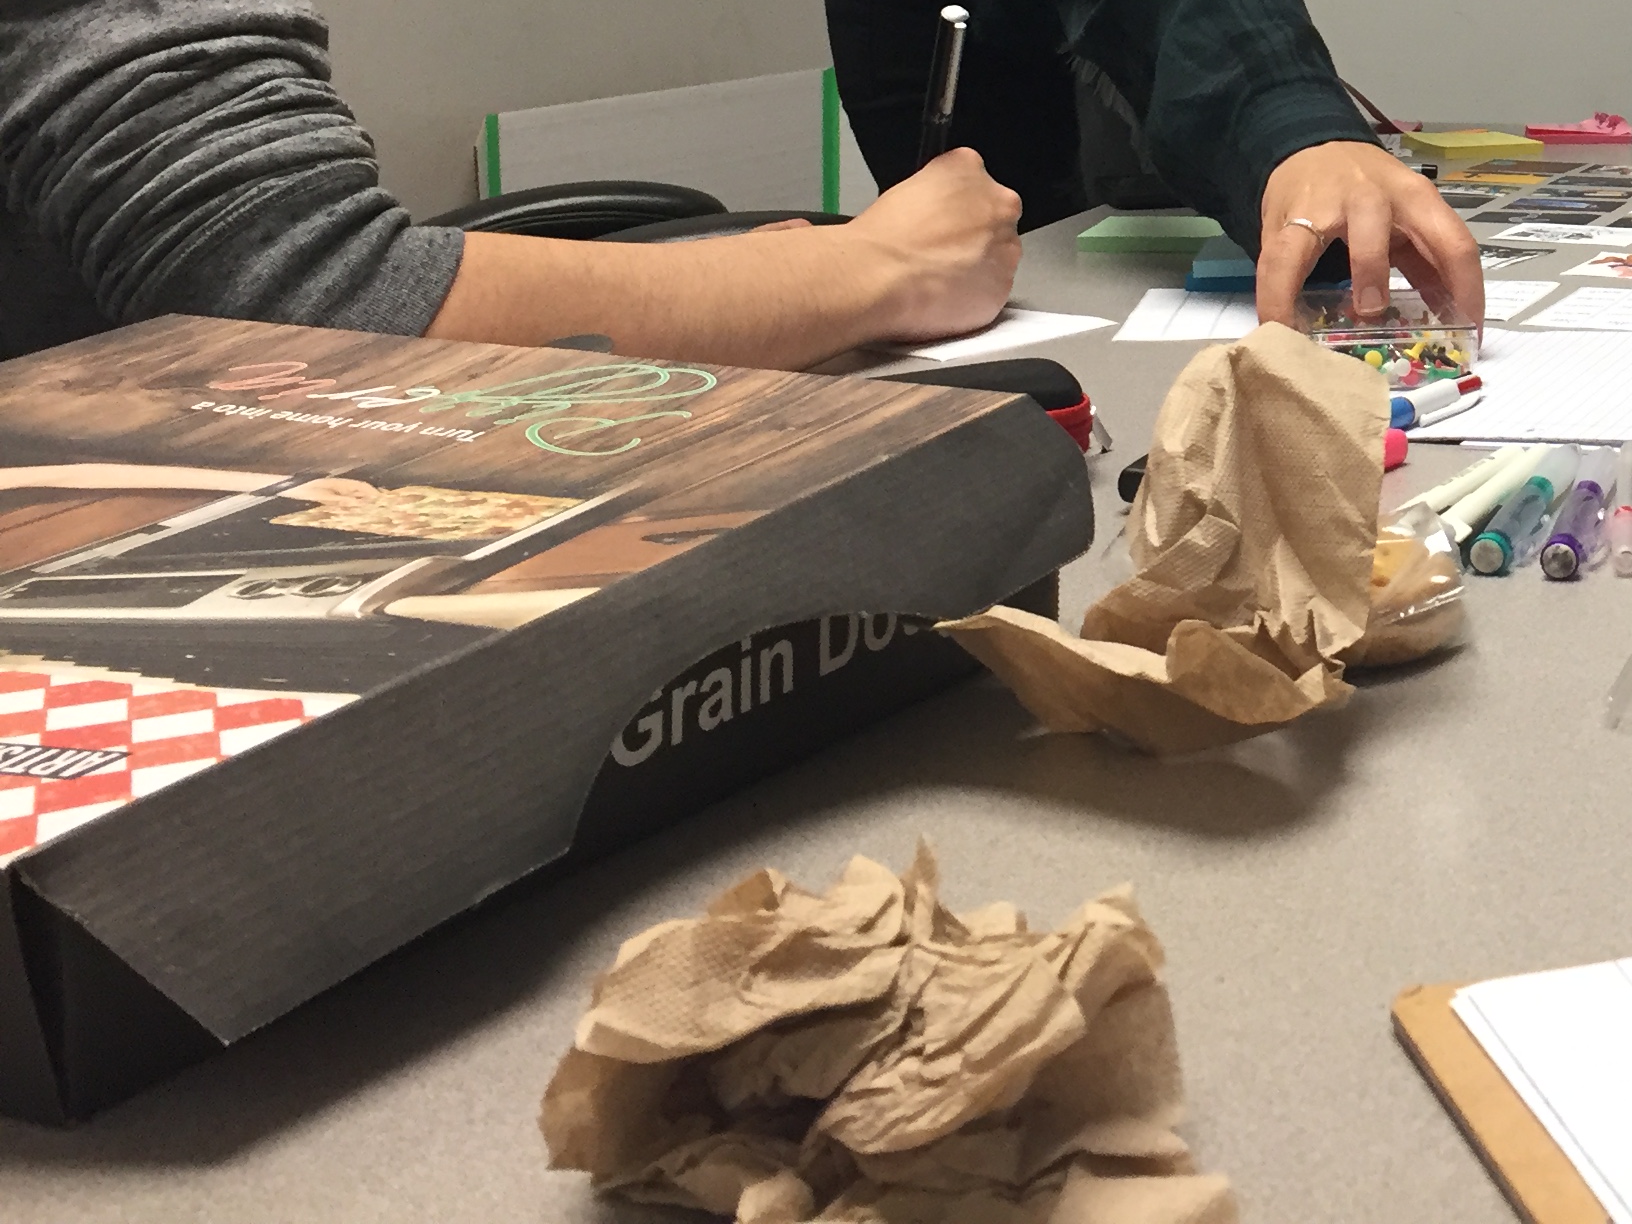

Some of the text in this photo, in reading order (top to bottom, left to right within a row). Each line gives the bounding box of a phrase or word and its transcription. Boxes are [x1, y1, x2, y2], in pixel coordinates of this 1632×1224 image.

[191, 401, 487, 443] Turn your home into a
[610, 633, 795, 768] Grain
